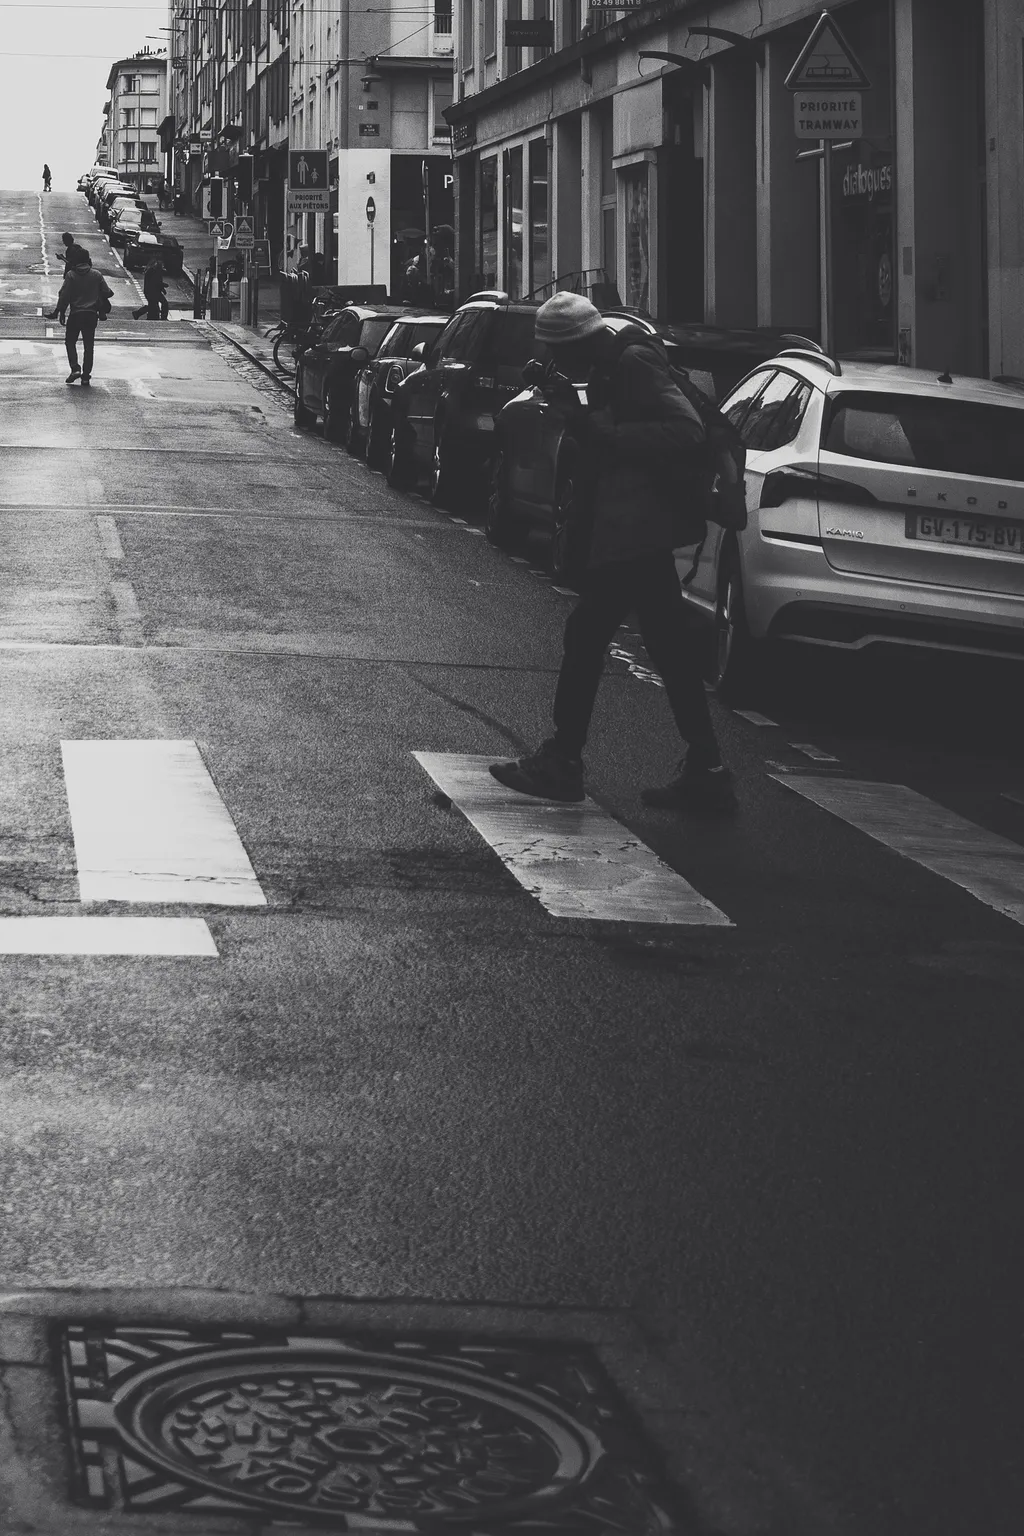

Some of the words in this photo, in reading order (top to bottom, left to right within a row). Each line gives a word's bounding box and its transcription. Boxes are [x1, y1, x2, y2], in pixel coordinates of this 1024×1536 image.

[592, 0, 601, 7] 02
[800, 99, 856, 112] PRIORITÉ
[798, 120, 859, 130] TRAMWAY
[843, 163, 893, 202] dialogues
[294, 193, 323, 201] PRIORITÉ
[289, 202, 302, 210] AUX
[302, 201, 329, 210] PIÉTONS
[825, 527, 865, 540] KAMIQ
